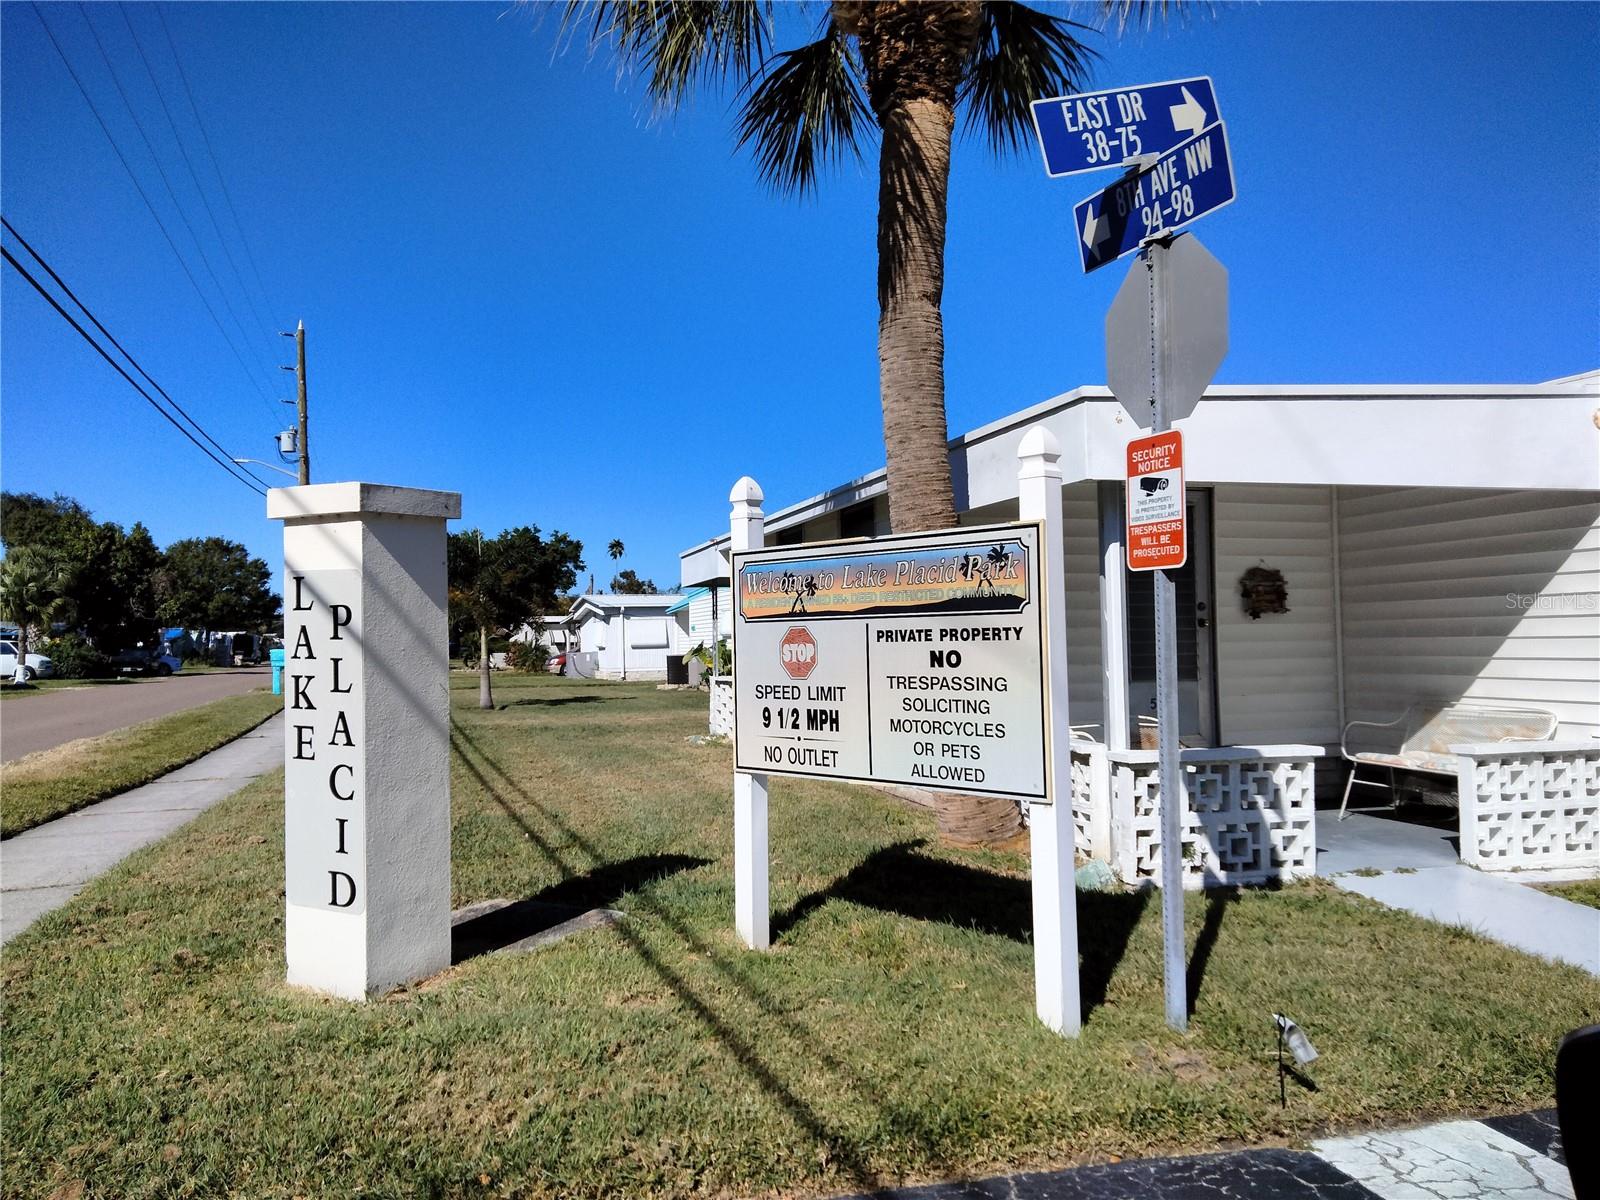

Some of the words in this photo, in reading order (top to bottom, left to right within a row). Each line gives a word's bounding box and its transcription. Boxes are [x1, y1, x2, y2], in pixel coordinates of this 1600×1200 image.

[1061, 97, 1111, 132] EAST
[1116, 92, 1147, 124] DR
[1081, 125, 1142, 164] 38-75
[1116, 177, 1144, 217] 8TH
[1151, 155, 1181, 200] AVE
[1184, 136, 1213, 180] NW
[1142, 185, 1195, 237] 94-98
[1131, 443, 1176, 463] SECURITY
[1137, 457, 1171, 473] NOTICE
[1130, 522, 1181, 536] TRESPASSERS
[1140, 536, 1158, 546] WILL
[1160, 534, 1171, 544] BE
[1133, 545, 1180, 559] PROSECUTED
[746, 570, 812, 594] Welcome
[818, 570, 834, 590] to
[841, 563, 888, 589] Lake
[893, 556, 959, 586] Placid
[964, 551, 1020, 581] Park
[879, 588, 944, 602] RESTRICTED
[946, 584, 1018, 599] COMMUNITY
[876, 628, 933, 642] PRIVATE
[939, 627, 1023, 642] PROPERTY
[781, 643, 815, 663] STOP
[929, 650, 962, 668] NO
[291, 576, 317, 760] LAKE
[755, 685, 801, 700] SPEED
[807, 686, 846, 701] LIMIT
[886, 676, 1008, 692] TRESPASSING
[902, 697, 990, 714] SOLICITING
[762, 706, 771, 728] 9
[777, 707, 800, 729] 1/2
[806, 708, 840, 732] MPH
[890, 719, 1006, 738] MOTORCYCLES
[328, 604, 357, 908] PLACID
[764, 746, 782, 763] NO
[787, 747, 839, 768] OUTLET
[913, 741, 934, 757] OR
[941, 744, 981, 760] PETS
[911, 764, 985, 783] ALLOWED
